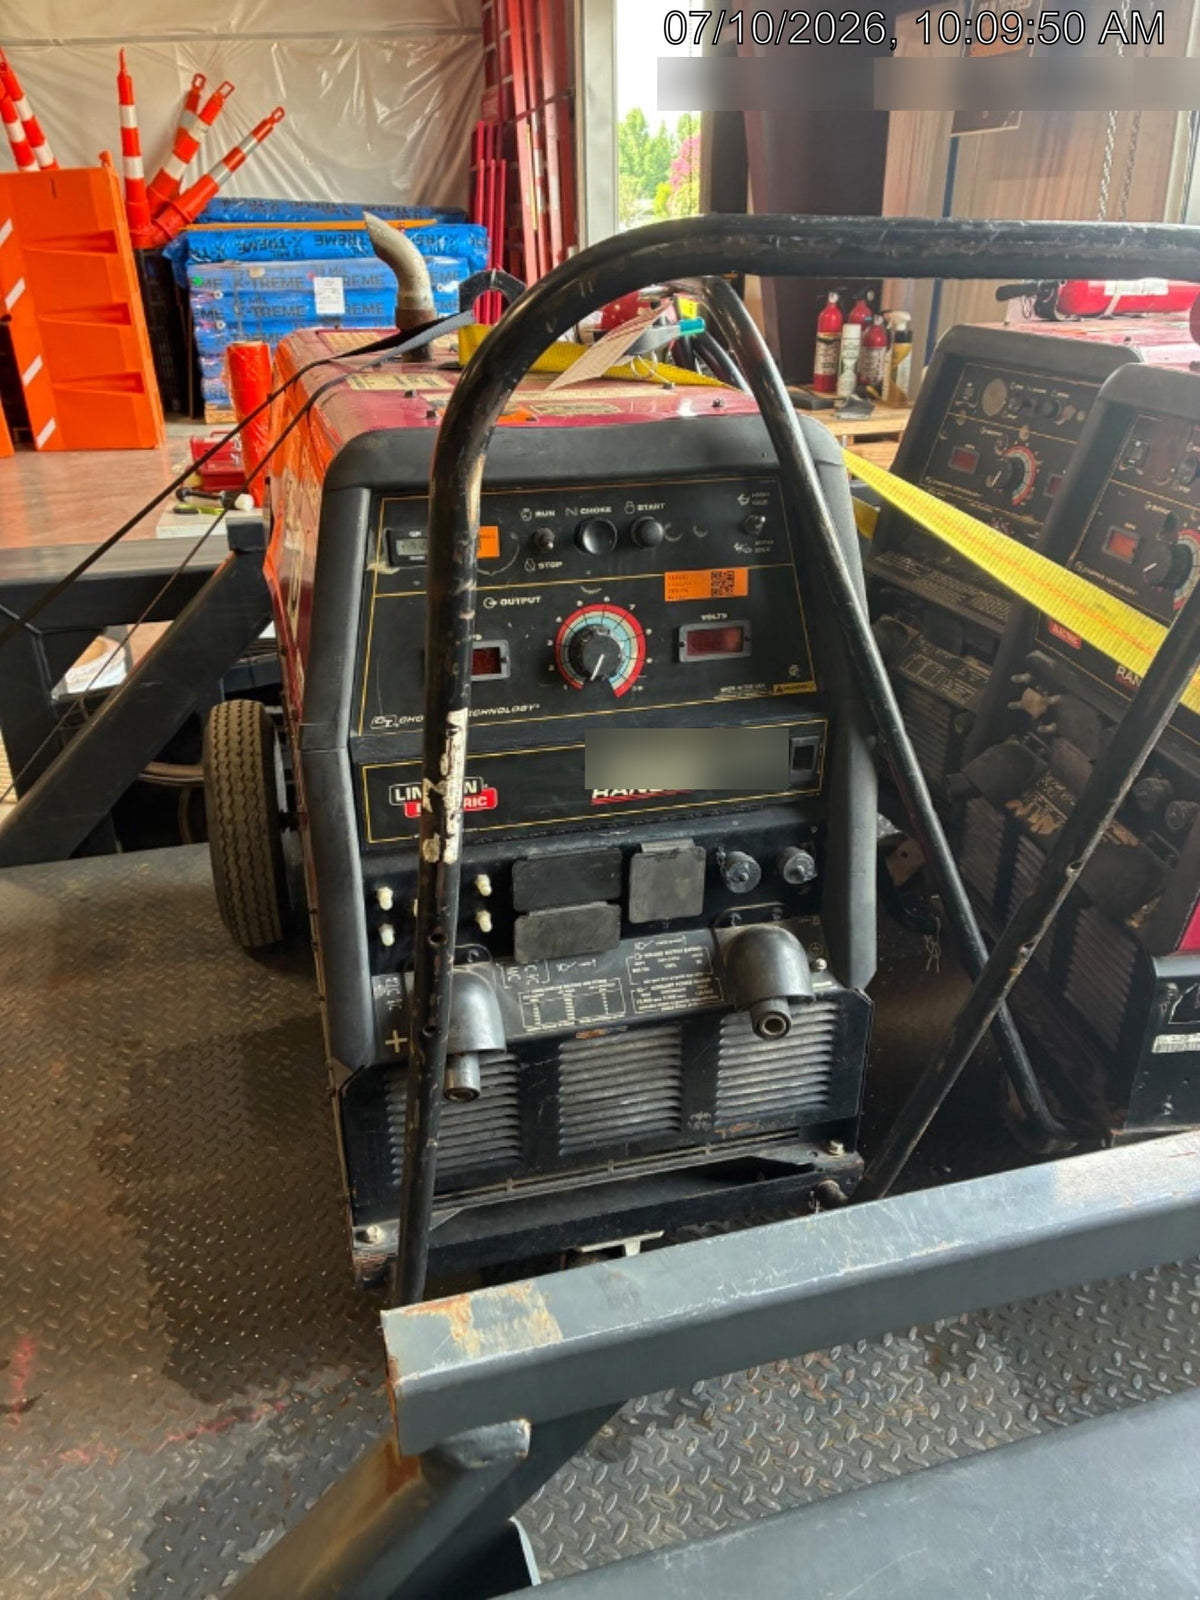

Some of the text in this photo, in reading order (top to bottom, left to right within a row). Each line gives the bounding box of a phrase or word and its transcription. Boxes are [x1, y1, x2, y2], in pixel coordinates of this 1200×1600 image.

[535, 502, 666, 517] RUN CHOKE START
[537, 561, 563, 570] STOP
[500, 596, 542, 606] OUTPUT
